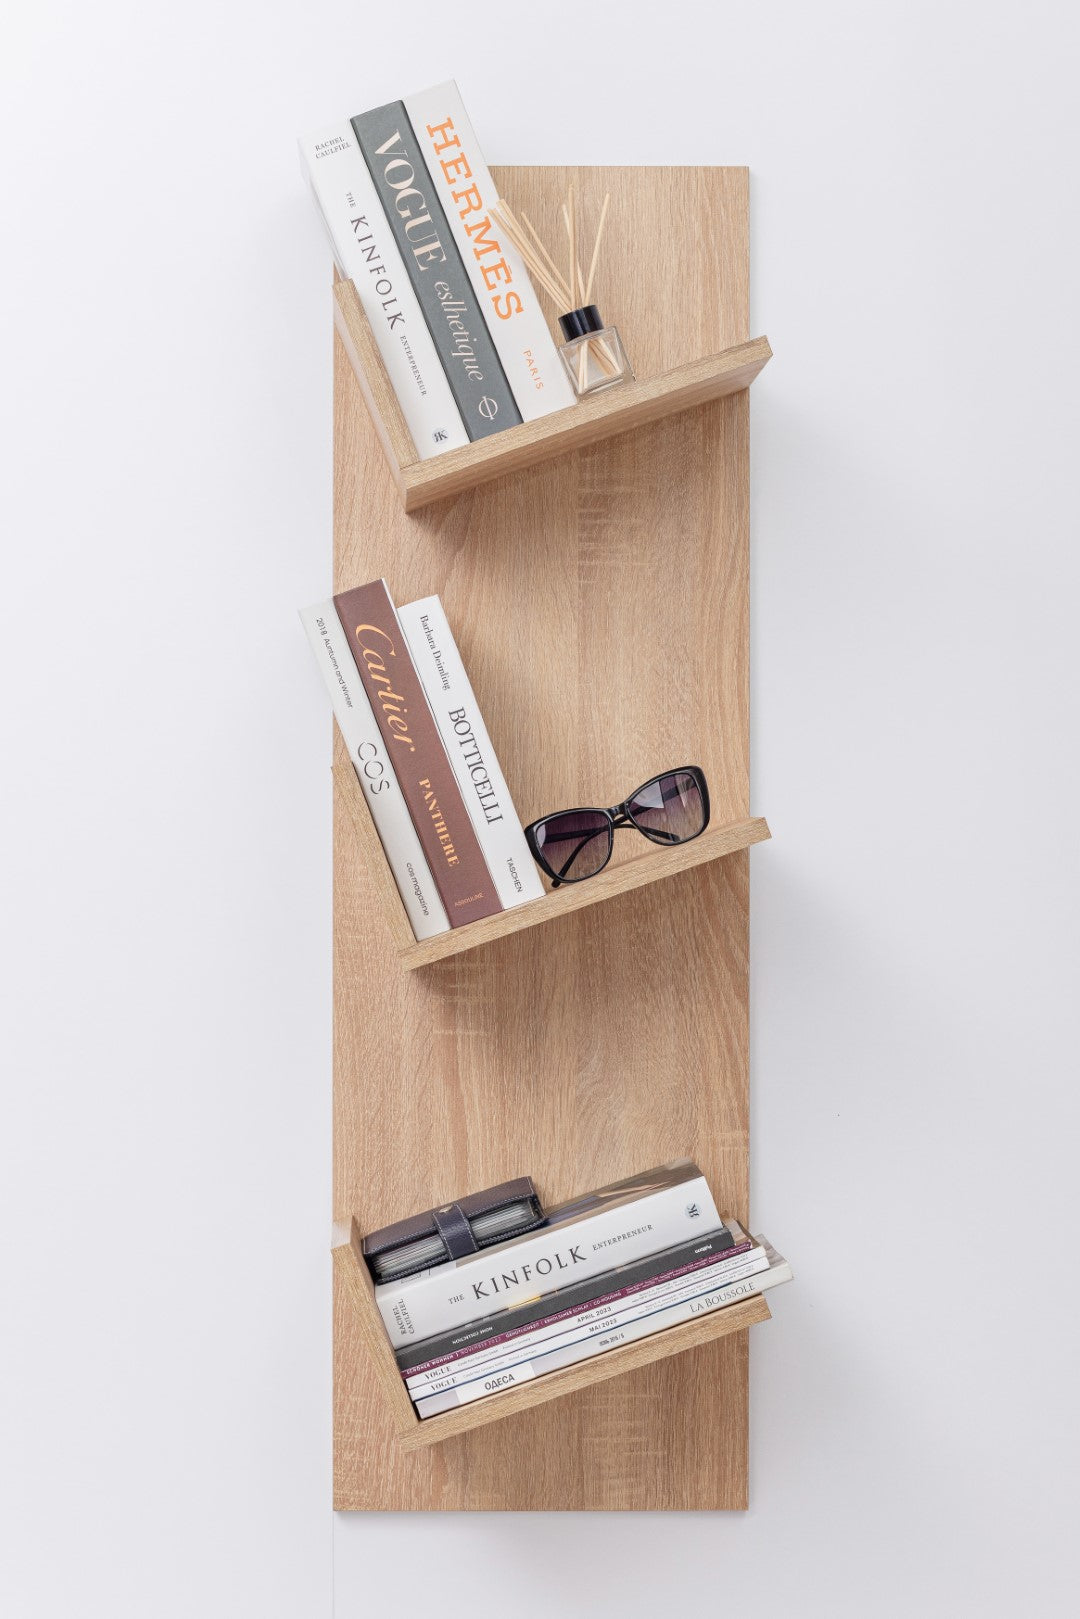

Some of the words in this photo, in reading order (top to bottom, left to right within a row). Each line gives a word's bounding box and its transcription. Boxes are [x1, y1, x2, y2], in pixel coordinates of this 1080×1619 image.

[315, 136, 345, 152] RACHEL
[315, 142, 351, 159] CAULFIEL
[346, 192, 357, 208] THE
[374, 129, 447, 272] VOGUE
[351, 215, 406, 331] KINFOLK
[400, 335, 427, 396] ENTERPRENEUR
[523, 350, 544, 390] PARIS
[316, 617, 328, 636] 2018
[336, 671, 345, 685] and
[341, 683, 353, 708] Winter
[420, 614, 436, 650] Barbara
[433, 649, 451, 691] Deimling
[355, 624, 416, 752] Cartier
[357, 742, 390, 794] COS
[448, 706, 504, 825] BOTTICELLI
[418, 778, 460, 867] PANTHERE
[506, 857, 522, 893] TASCHEN
[448, 1294, 465, 1305] THE
[471, 1245, 587, 1300] KINFOLK
[592, 1224, 654, 1251] ENTERPRENEUR
[392, 1305, 406, 1335] RACHEL
[690, 1301, 704, 1313] LA
[705, 1283, 756, 1308] BOUSSOLE
[425, 1366, 452, 1380] VOGUE
[577, 1313, 595, 1323] APRIL
[596, 1307, 612, 1316] 2023
[430, 1377, 458, 1391] VOGUE
[589, 1325, 601, 1333] MAI
[602, 1318, 617, 1328] 2023
[452, 1331, 480, 1345] COLLECTION
[484, 1374, 515, 1391] ОДЕСА
